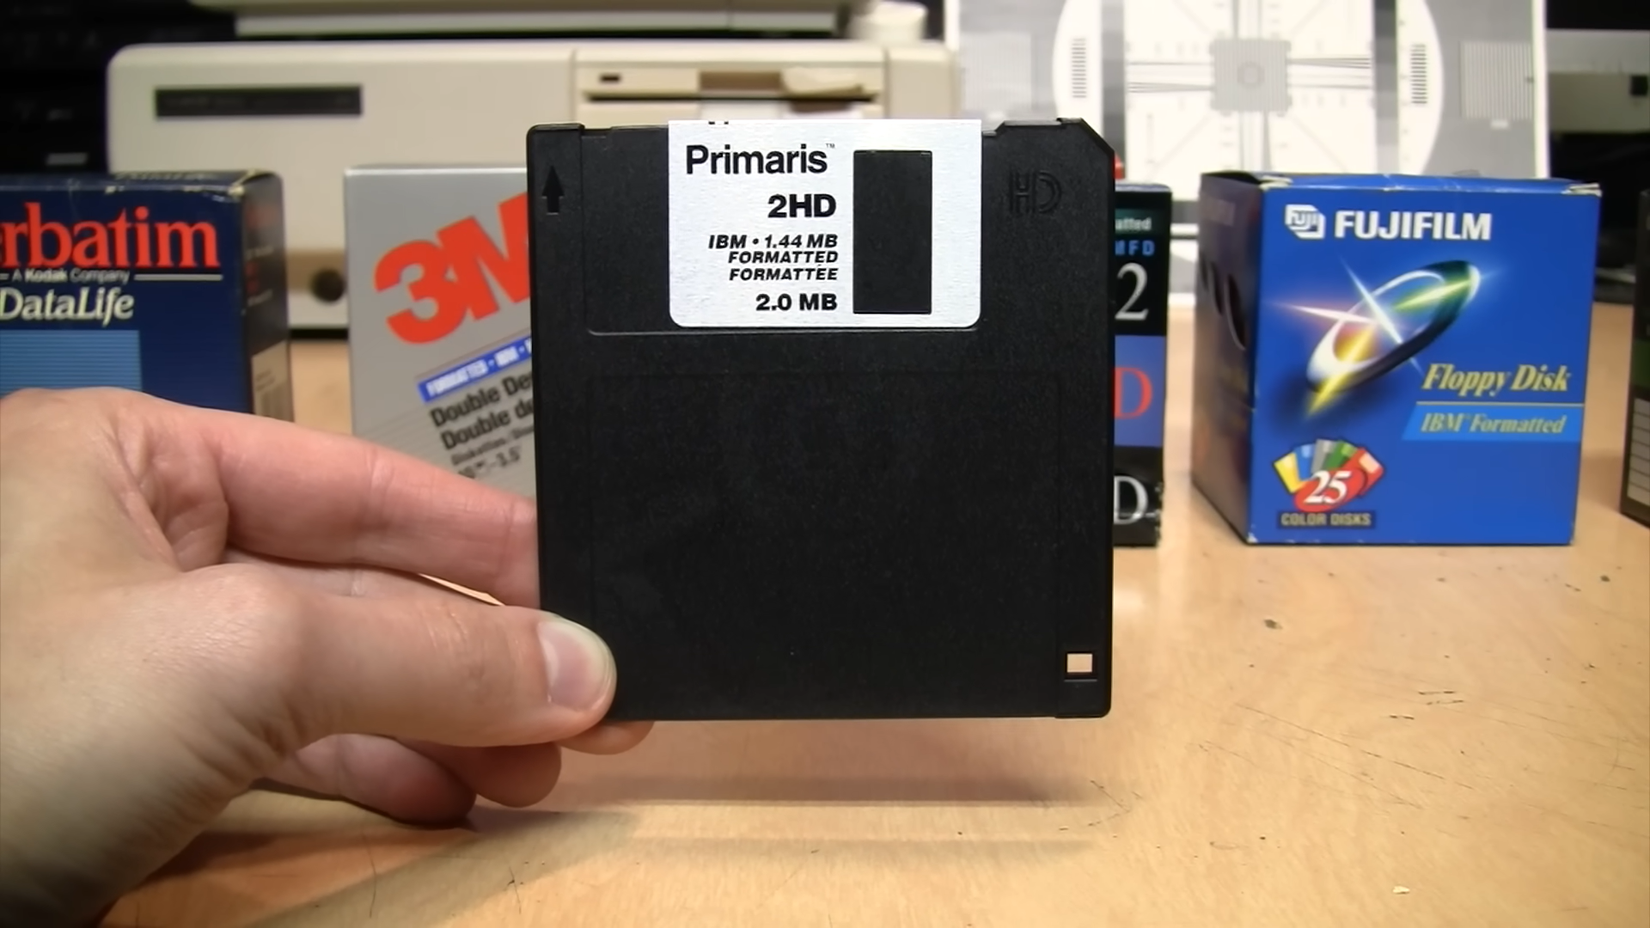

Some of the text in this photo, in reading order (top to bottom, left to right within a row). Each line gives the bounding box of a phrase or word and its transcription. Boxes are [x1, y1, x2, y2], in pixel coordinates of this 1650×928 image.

[686, 143, 828, 175] Primaris
[767, 193, 837, 218] 2HD
[1008, 170, 1062, 215] HD
[0, 202, 221, 268] rbatim
[1115, 217, 1152, 231] atted
[1334, 210, 1493, 241] FUJIFILM
[708, 234, 839, 249] IBM 1.44 MB
[728, 250, 839, 264] FORMATTED
[12, 267, 130, 285] A Kodak Company
[374, 191, 531, 344] 3M
[729, 264, 840, 281] FORMATTÉE
[0, 286, 135, 328] DataLife
[756, 293, 838, 311] 2.0 MB
[1420, 363, 1571, 397] Floppy Disk
[430, 374, 533, 427] Double De
[441, 410, 511, 450] Double
[1420, 412, 1568, 434] IBM Formatted
[1303, 470, 1353, 504] 25
[1281, 513, 1373, 527] COLOR DISKS
